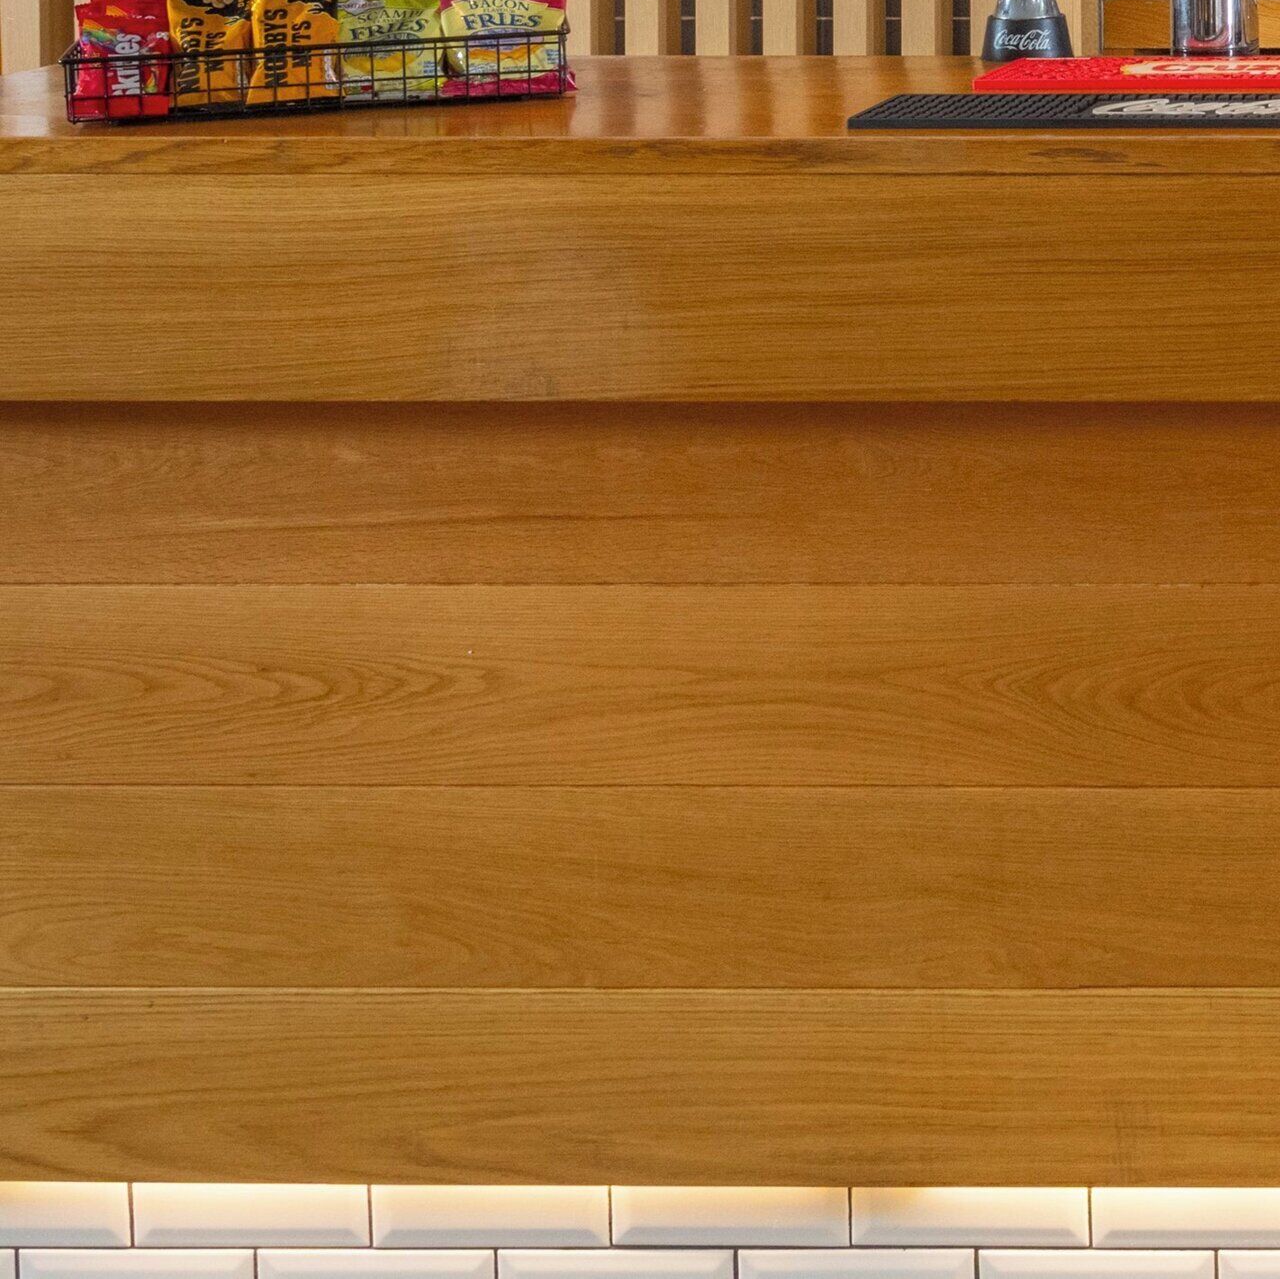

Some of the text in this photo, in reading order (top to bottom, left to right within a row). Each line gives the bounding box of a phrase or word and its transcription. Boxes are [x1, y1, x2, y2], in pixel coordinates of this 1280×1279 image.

[357, 9, 424, 24] SCAMPI
[462, 13, 543, 30] FRIES
[350, 18, 429, 41] FRIES
[993, 29, 1052, 51] Coca-Cola
